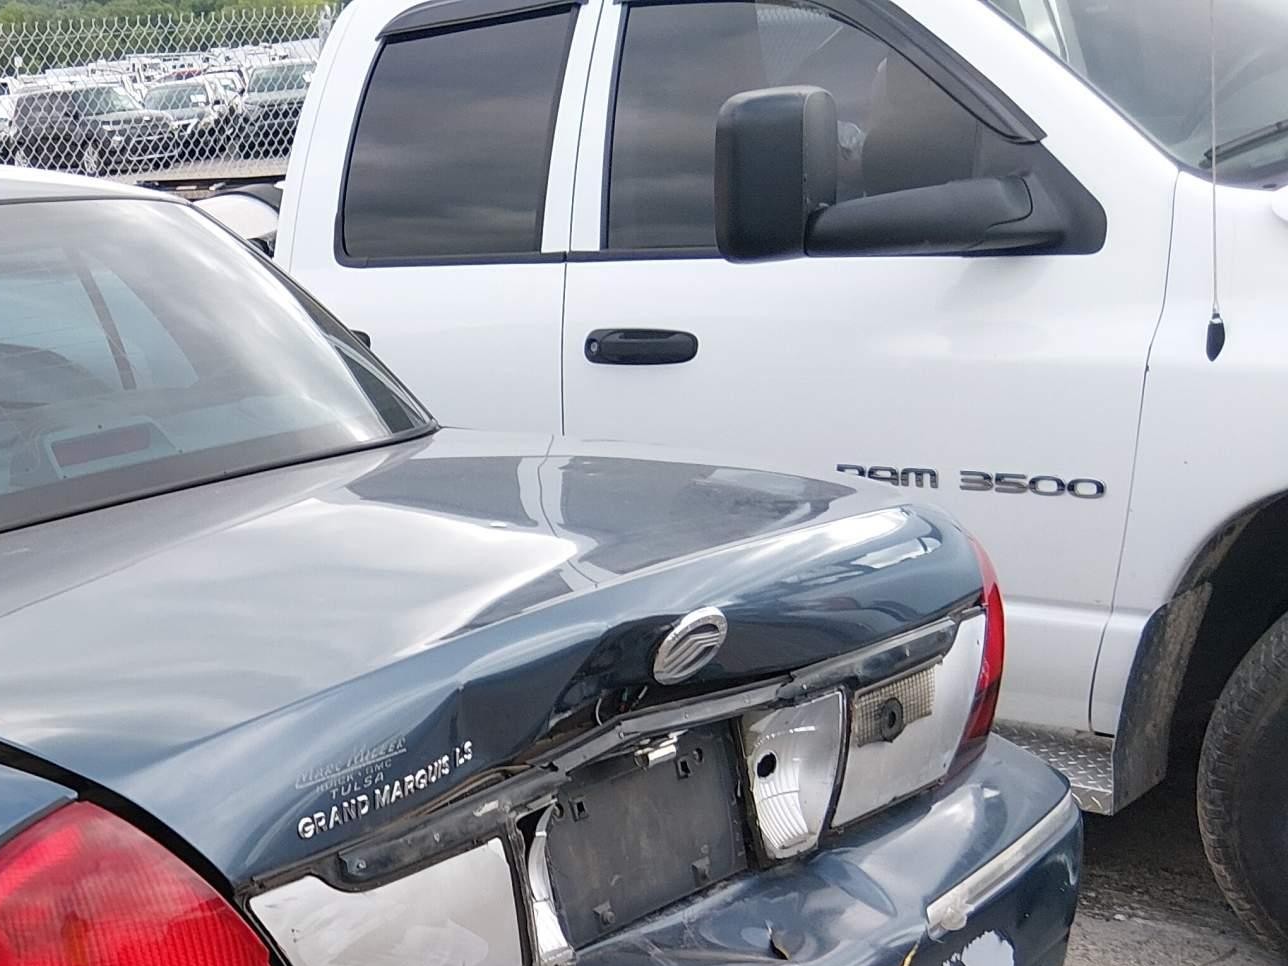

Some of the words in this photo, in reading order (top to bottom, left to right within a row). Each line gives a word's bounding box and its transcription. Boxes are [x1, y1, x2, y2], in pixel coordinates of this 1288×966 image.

[959, 470, 1106, 499] 3500
[297, 794, 369, 839] GRAND
[374, 754, 450, 810] MARQUIS
[455, 740, 473, 767] LS
[330, 771, 385, 800] TULSA
